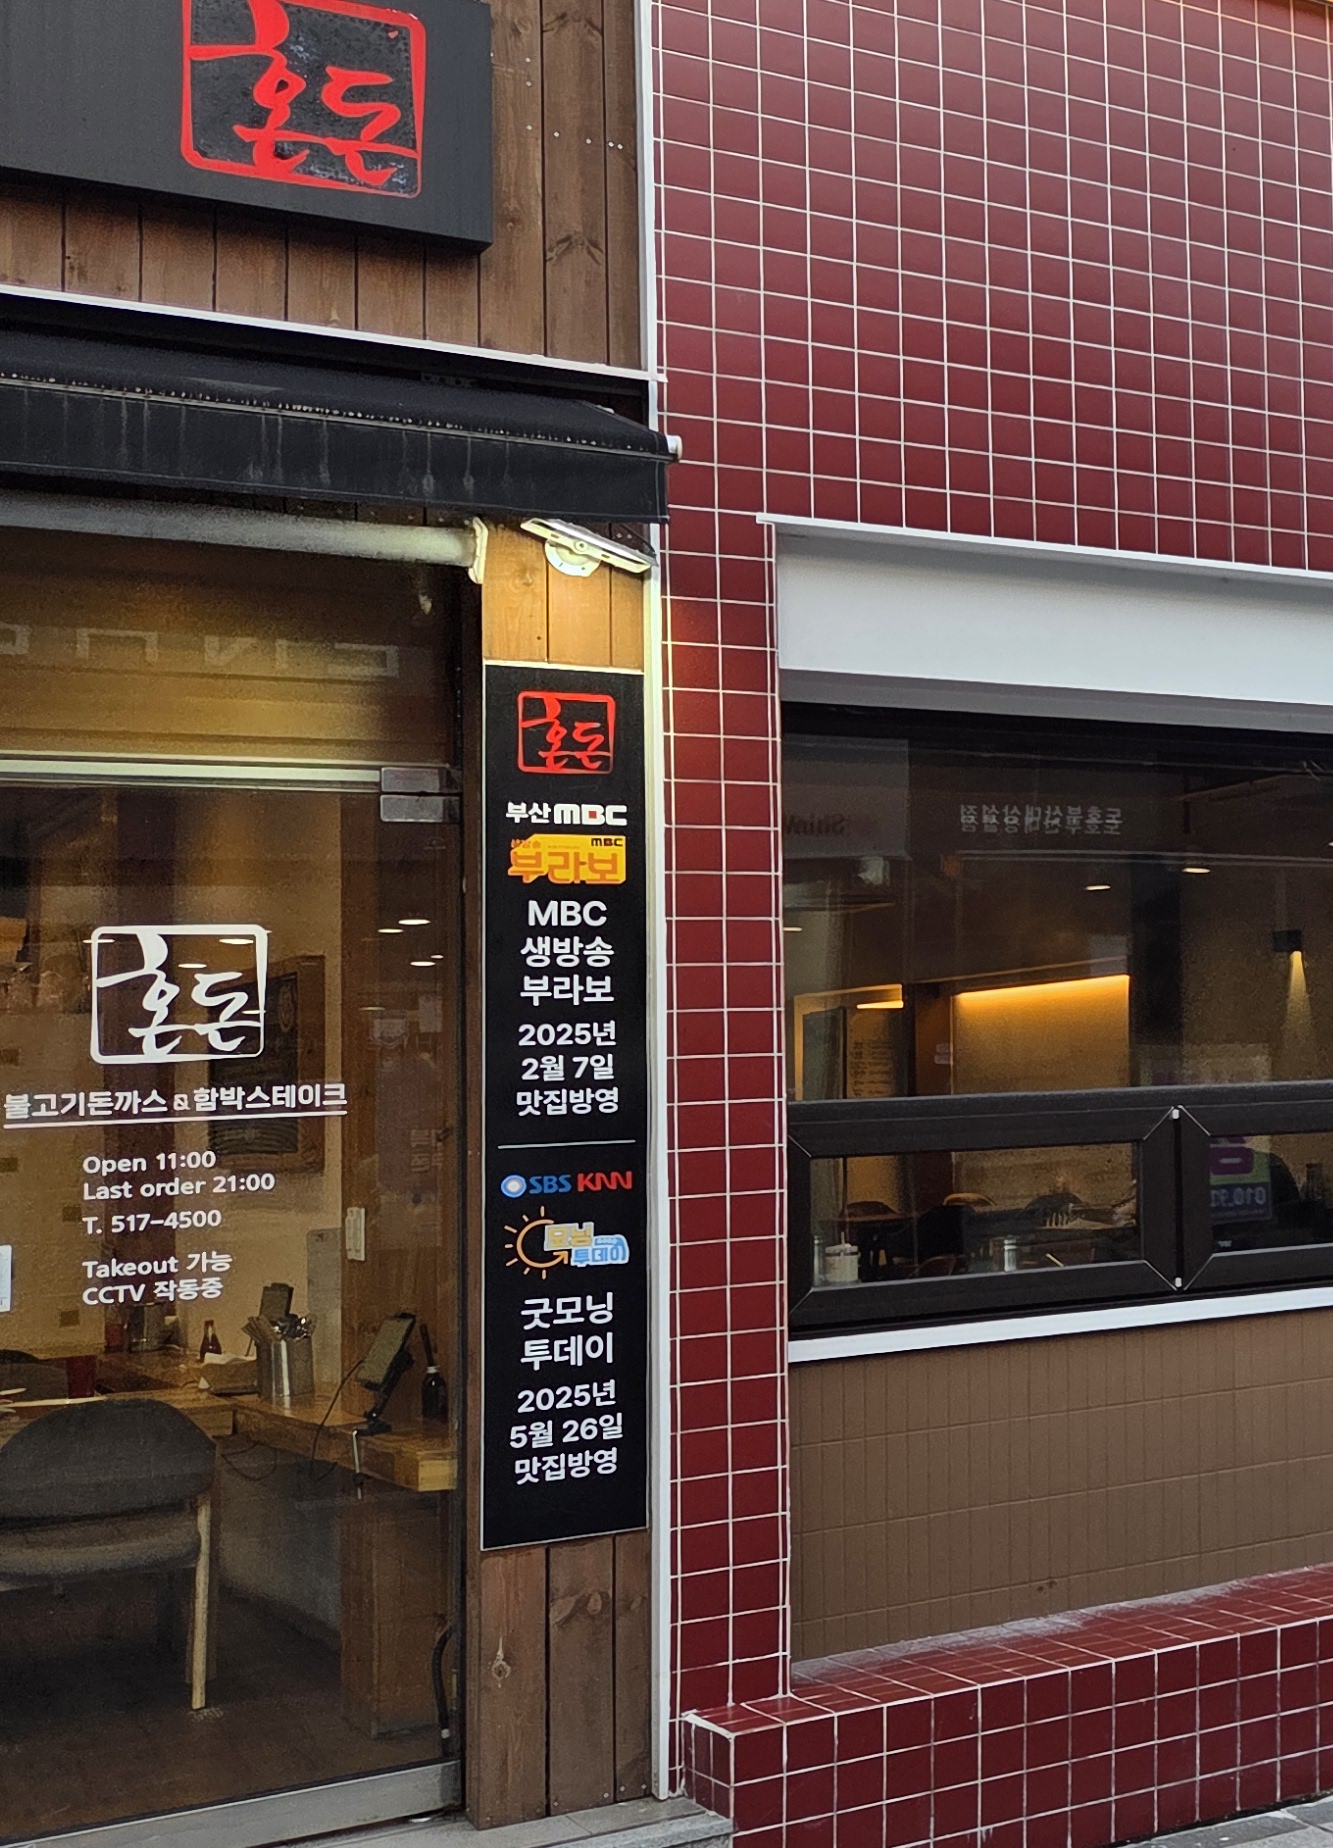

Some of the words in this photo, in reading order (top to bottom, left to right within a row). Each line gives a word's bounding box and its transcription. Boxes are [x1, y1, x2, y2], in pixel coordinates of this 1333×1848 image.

[590, 837, 625, 848] MBC
[508, 851, 622, 885] 부라보
[528, 899, 608, 927] MBC
[520, 936, 615, 967] 생방송
[520, 974, 615, 1006] 부라보
[518, 1020, 617, 1046] 2025년
[521, 1054, 565, 1082] 2월
[572, 1053, 615, 1081] 7일
[3, 1088, 168, 1120] 불고기돈까스
[173, 1094, 191, 1111] &
[193, 1082, 348, 1111] 함박스테이크
[516, 1087, 620, 1117] 맛집방영
[82, 1156, 147, 1179] Open
[156, 1151, 217, 1171] 11:00
[83, 1180, 133, 1200] Last
[140, 1176, 206, 1197] order
[212, 1173, 276, 1193] 21:00
[529, 1174, 572, 1194] SBS
[577, 1171, 633, 1192] KNN
[82, 1215, 103, 1235] T.
[111, 1209, 222, 1234] 517-4500
[547, 1224, 593, 1247] 모닝
[82, 1256, 178, 1278] Takeout
[186, 1251, 233, 1274] 가능
[572, 1237, 629, 1265] 투데이
[82, 1283, 146, 1306] CCTV
[153, 1277, 224, 1301] 작동중
[520, 1291, 614, 1330] 굿모닝
[520, 1332, 614, 1371] 투데이
[517, 1379, 616, 1413] 2025년
[509, 1420, 554, 1449] 5월
[562, 1412, 624, 1443] 26일
[514, 1447, 618, 1485] 맛집방영
